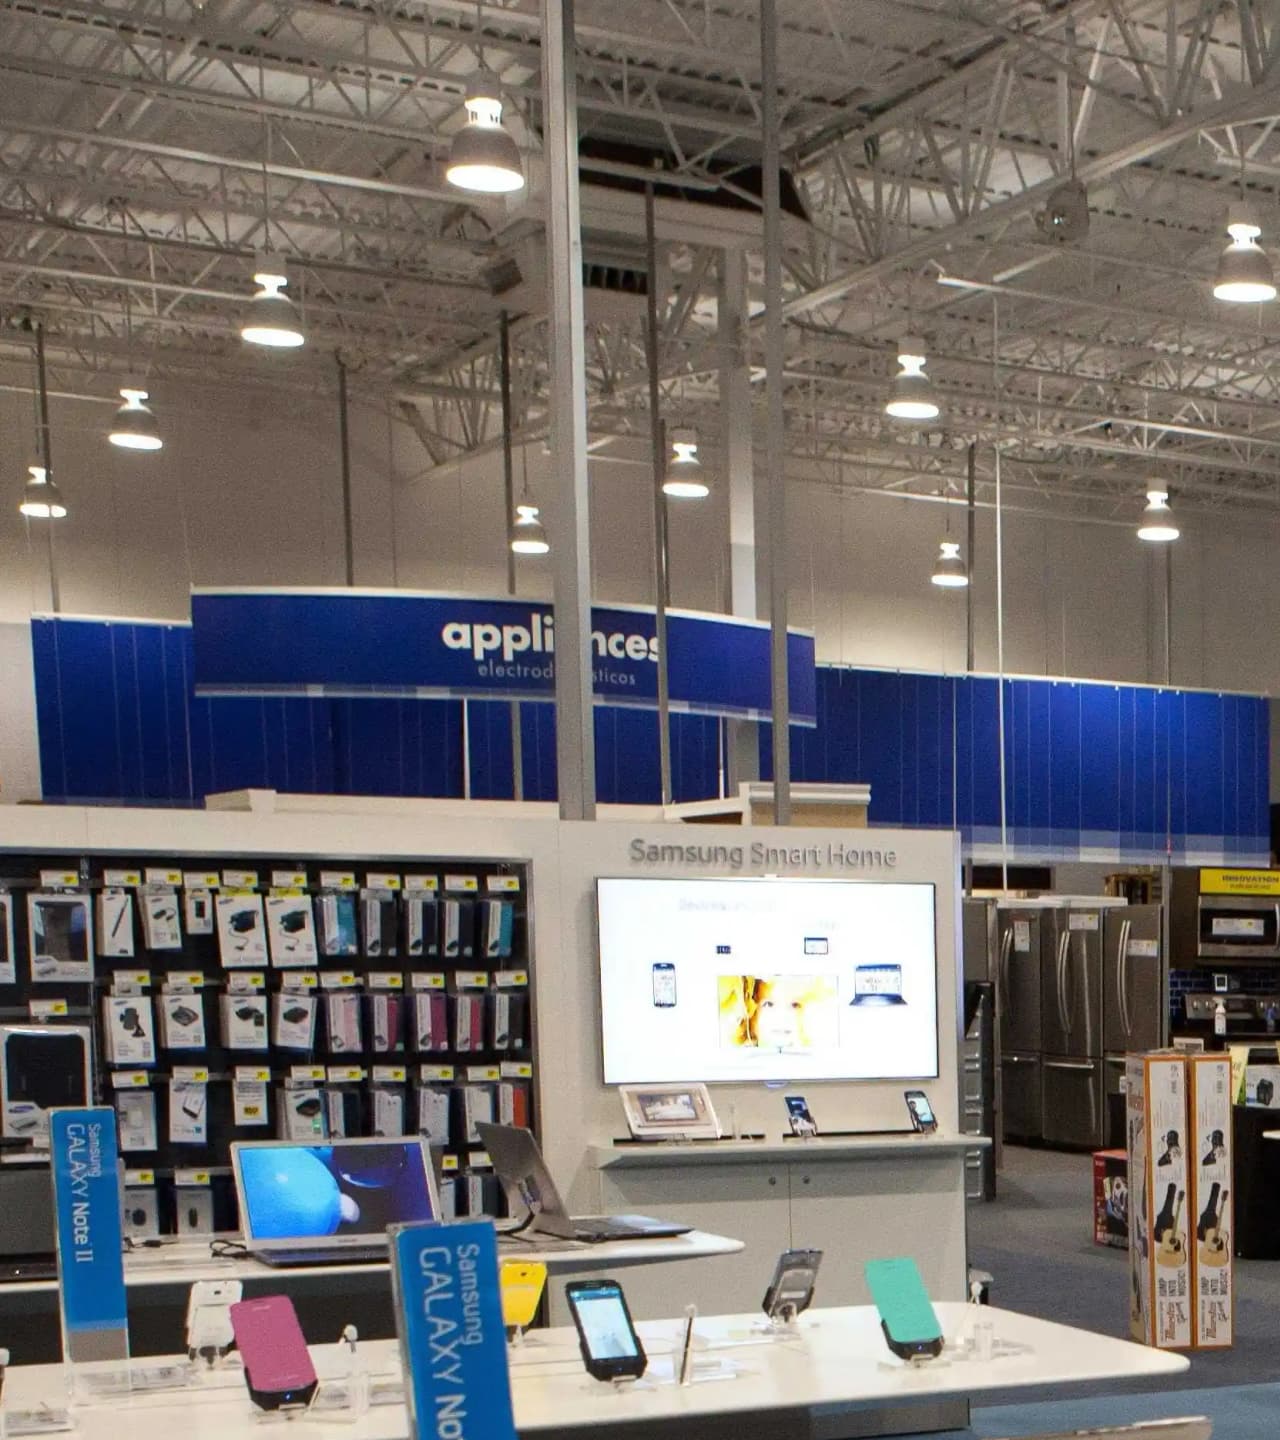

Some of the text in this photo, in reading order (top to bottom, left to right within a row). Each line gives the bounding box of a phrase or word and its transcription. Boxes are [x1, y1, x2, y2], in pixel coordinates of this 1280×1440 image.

[441, 613, 659, 662] applinces
[477, 658, 636, 686] electrodsticos
[629, 838, 898, 869] Samsung Smart Home
[66, 1124, 89, 1198] GALAXY
[88, 1123, 102, 1178] Samsung
[72, 1202, 91, 1245] Note
[419, 1246, 464, 1385] GALAXY
[457, 1243, 483, 1346] Samsung
